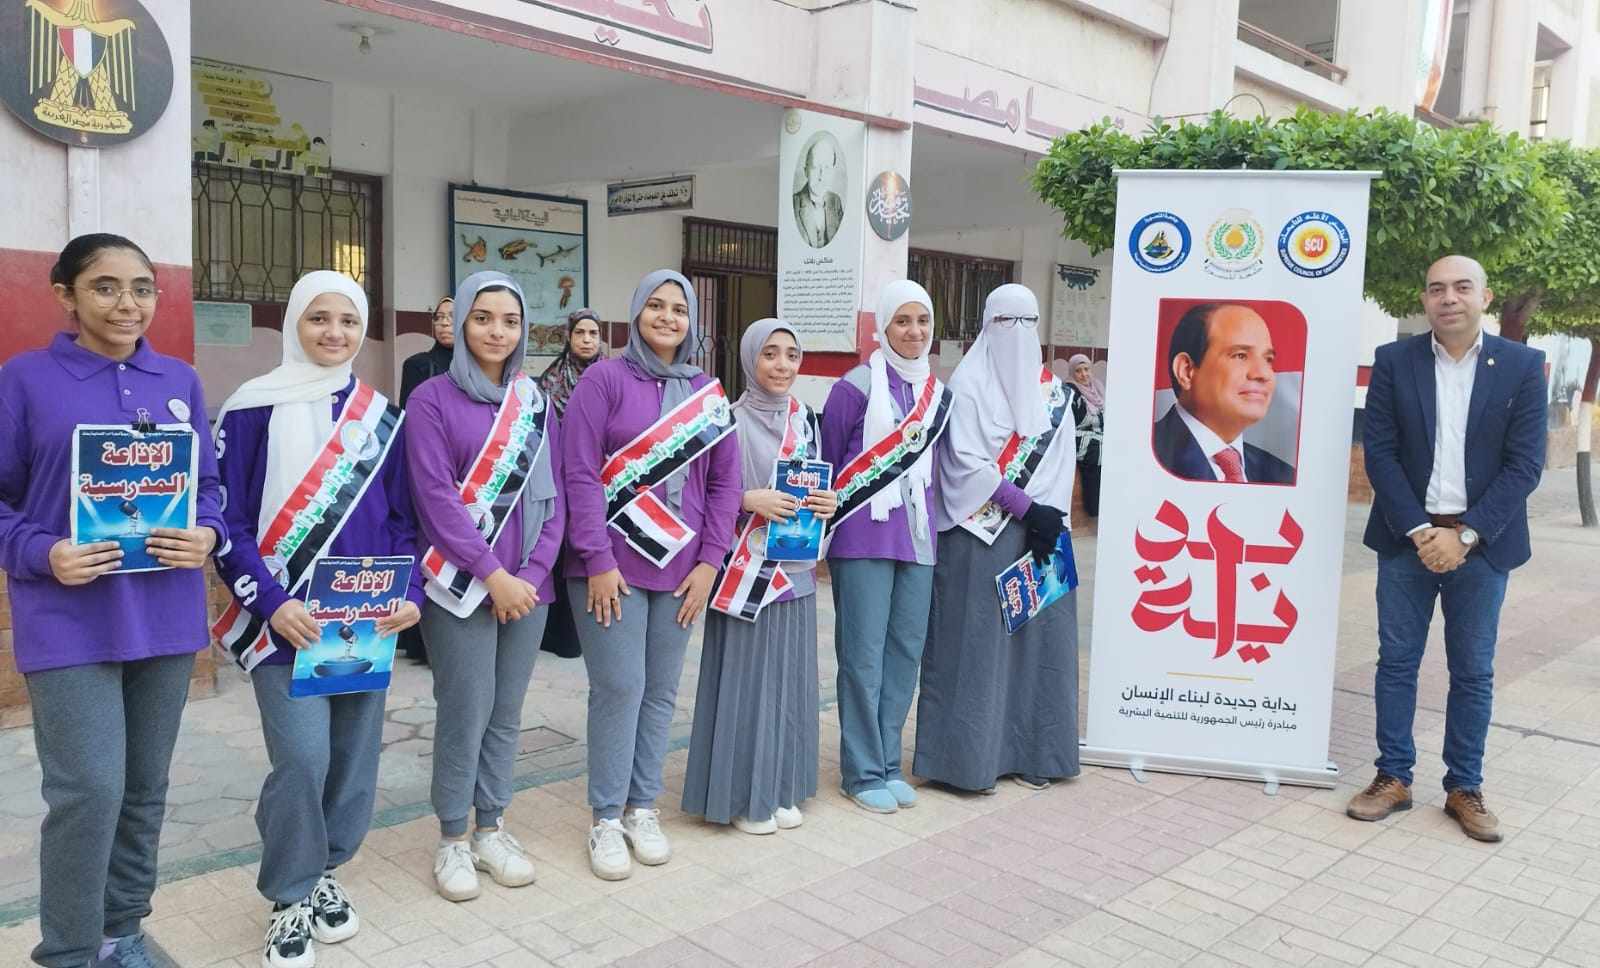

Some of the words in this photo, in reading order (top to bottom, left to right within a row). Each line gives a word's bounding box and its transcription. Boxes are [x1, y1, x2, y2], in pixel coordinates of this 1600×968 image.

[1304, 236, 1324, 252] SCU
[101, 441, 173, 471] الإذاعة
[79, 472, 187, 502] المدرسية
[330, 570, 395, 598] الإذاعة
[308, 599, 402, 626] المدرسية
[1121, 685, 1174, 705] الإنسان
[1178, 689, 1210, 707] لبناء
[1214, 692, 1257, 711] جديدة
[1118, 705, 1152, 719] البشرية
[1262, 696, 1297, 715] بداية
[1153, 709, 1188, 721] للتنمية
[1190, 712, 1237, 726] الجمهورية
[1239, 716, 1265, 729] رئيس
[1267, 719, 1297, 731] مبادرة
